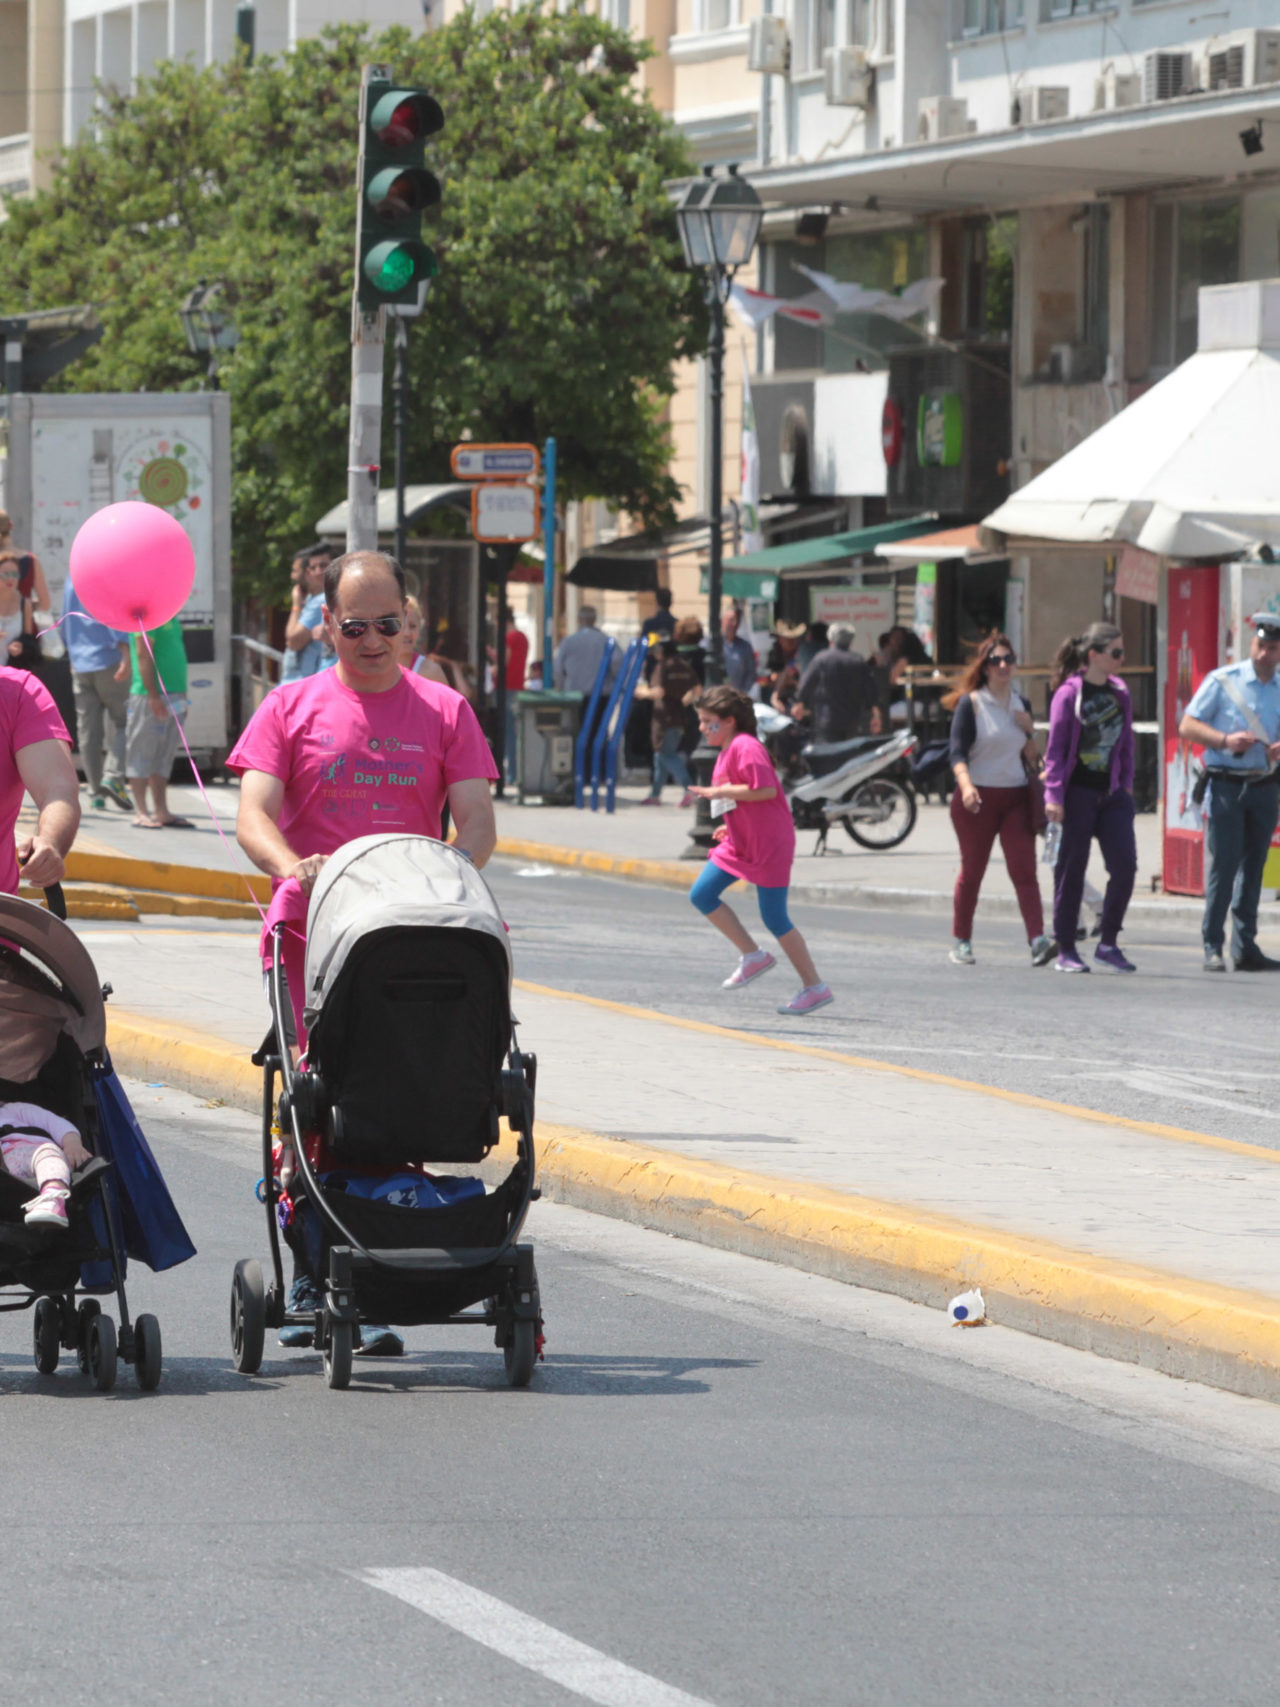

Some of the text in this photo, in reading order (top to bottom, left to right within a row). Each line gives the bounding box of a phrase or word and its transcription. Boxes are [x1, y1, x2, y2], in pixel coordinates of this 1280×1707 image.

[355, 758, 424, 772] Mother's
[354, 772, 417, 787] Day Run
